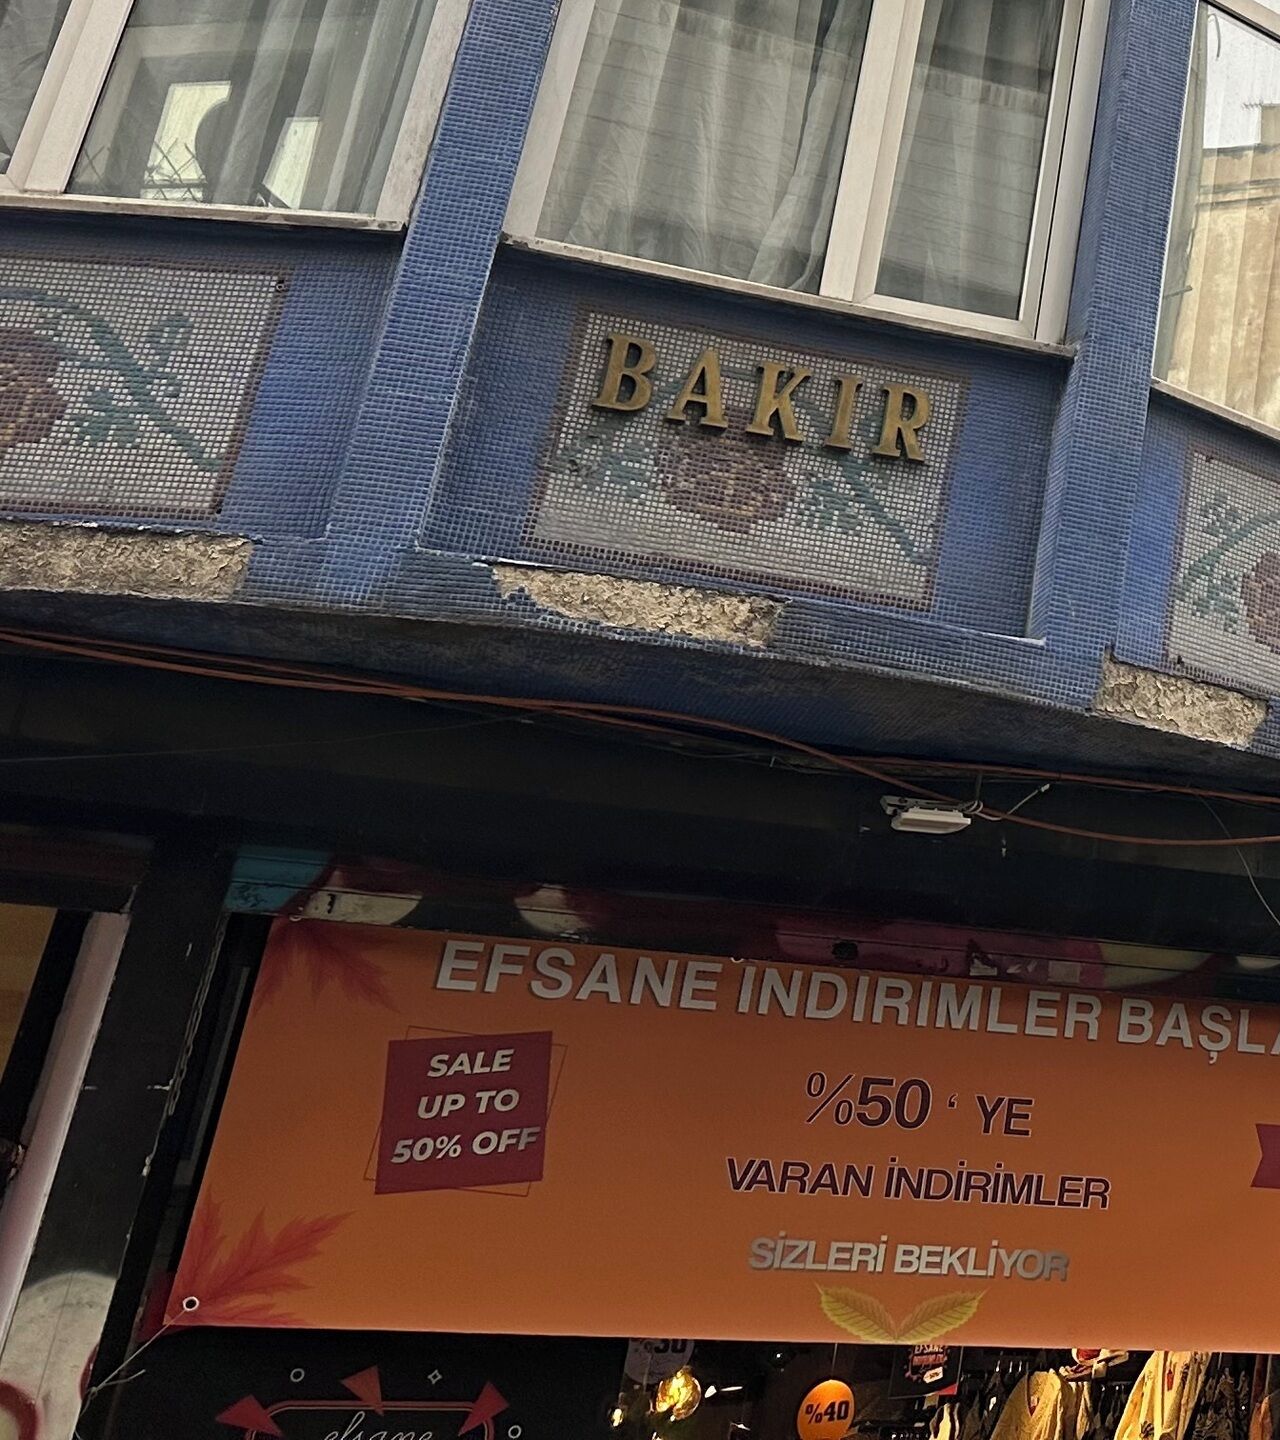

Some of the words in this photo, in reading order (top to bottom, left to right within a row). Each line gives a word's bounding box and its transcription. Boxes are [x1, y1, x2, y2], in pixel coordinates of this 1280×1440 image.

[592, 332, 930, 461] BAKIR
[436, 940, 718, 1011] EFSANE
[427, 1048, 514, 1078] SALE
[417, 1093, 466, 1120] UP
[475, 1088, 520, 1114] TO
[805, 1071, 932, 1129] %50
[976, 1094, 1034, 1137] YE
[390, 1134, 462, 1164] 50%
[472, 1126, 541, 1155] OFF
[726, 1157, 874, 1197] VARAN
[884, 1157, 1112, 1210] İNDİRİMLER
[748, 1231, 889, 1274] SİZLERİ
[893, 1240, 1071, 1281] BEKLİYOR
[805, 1401, 850, 1425] %40
